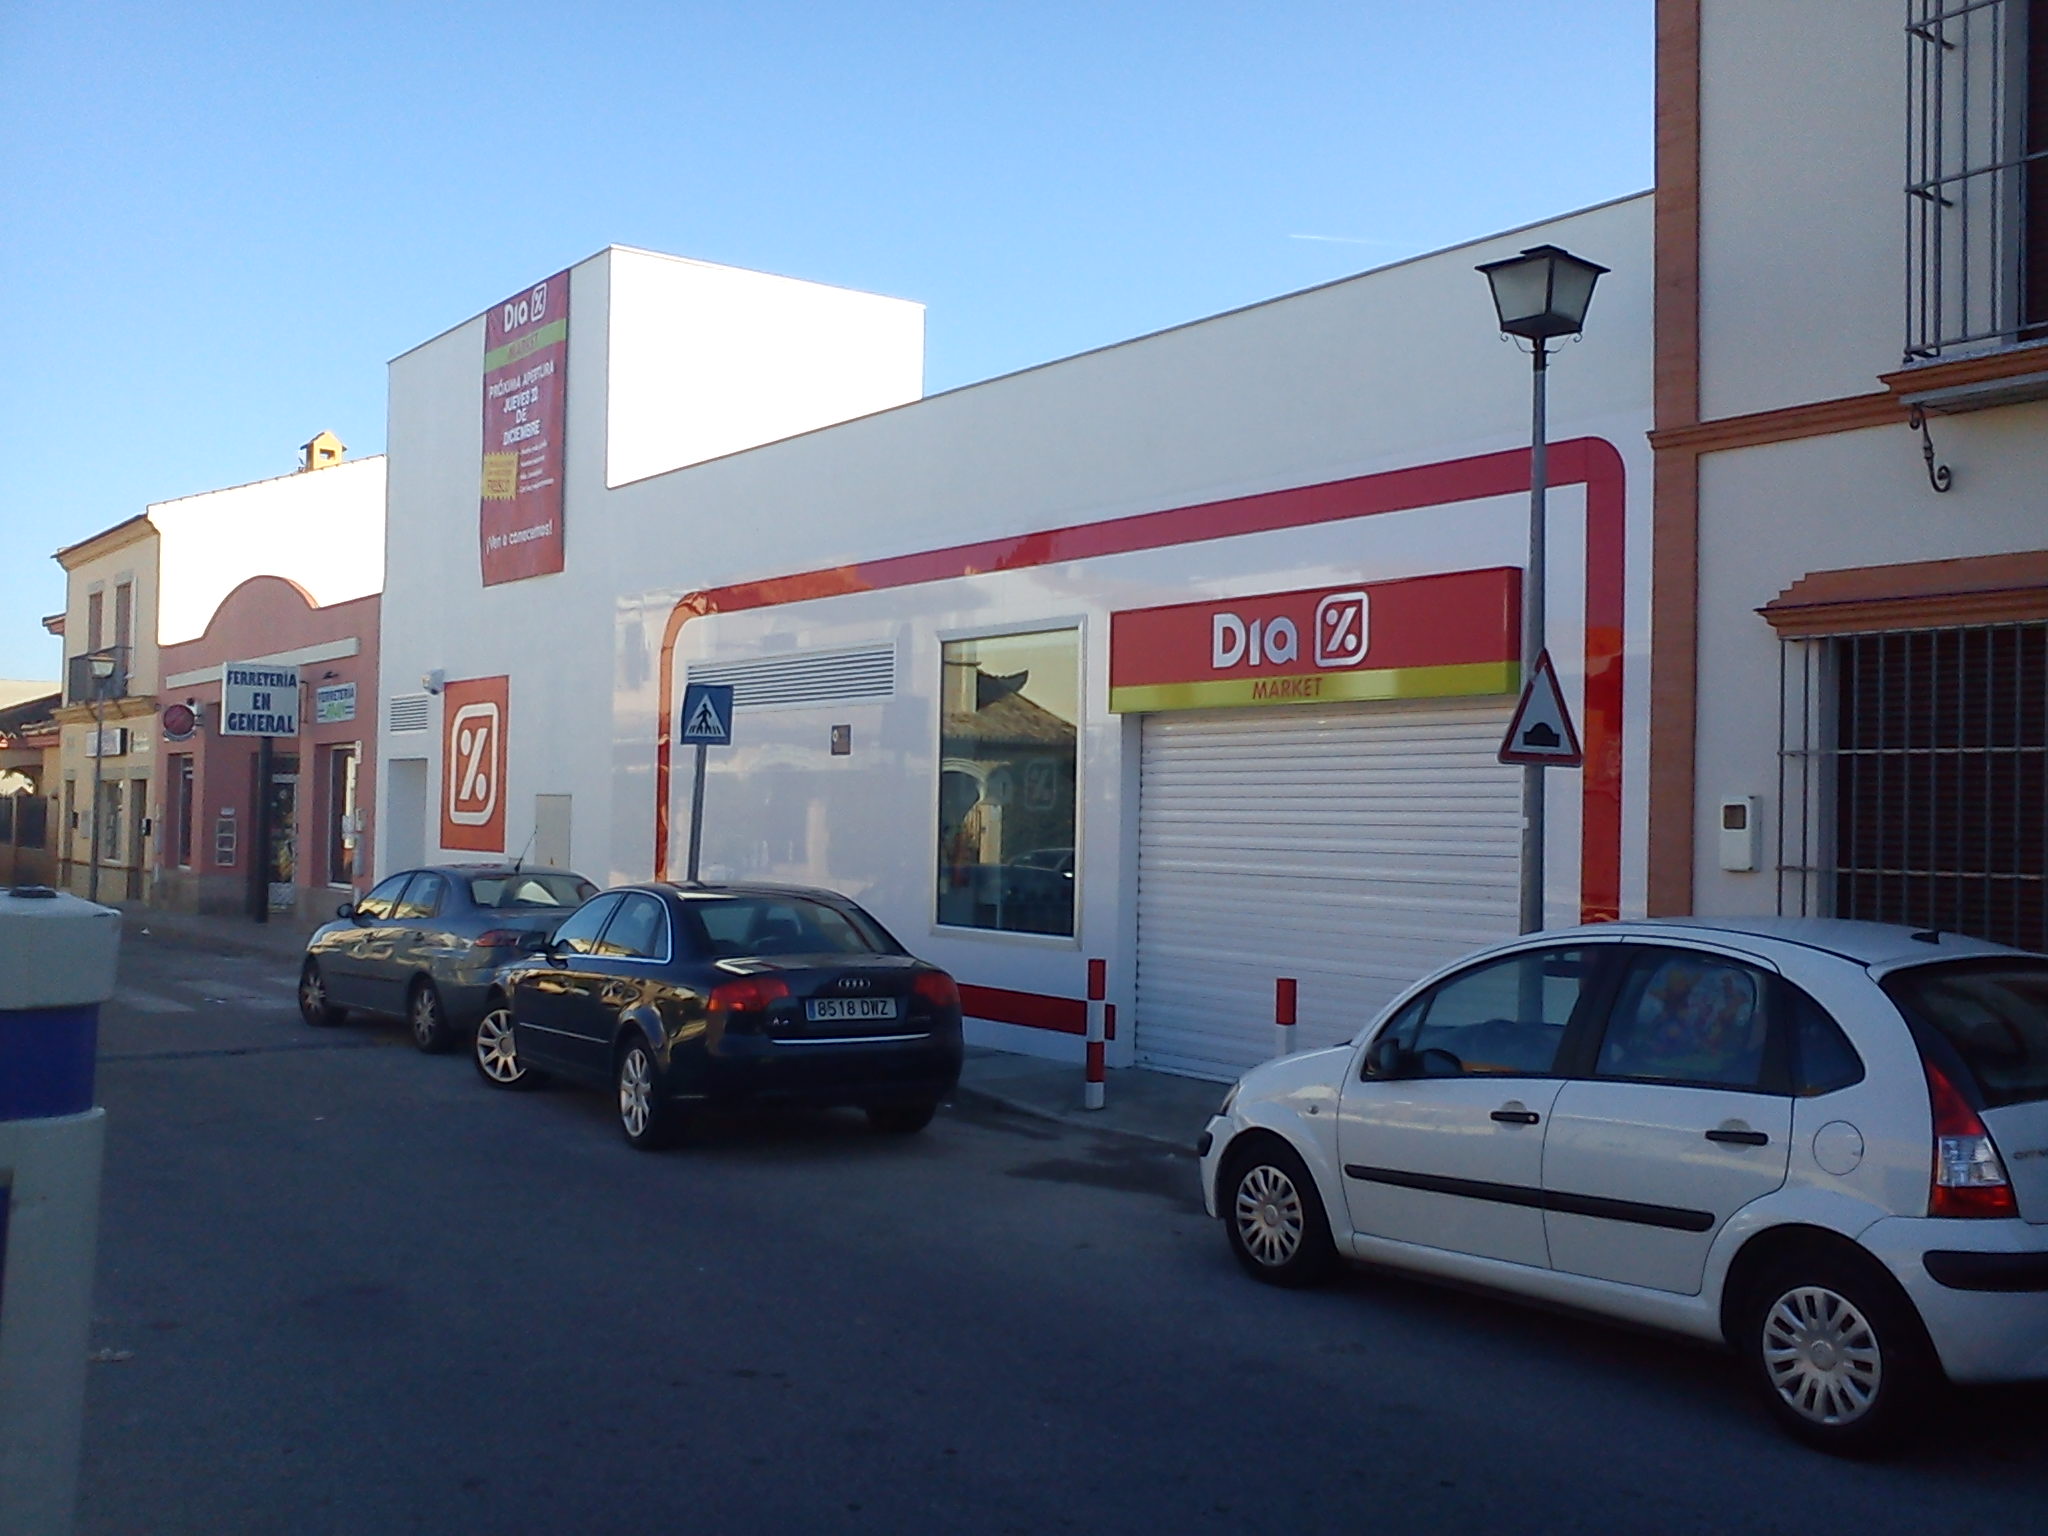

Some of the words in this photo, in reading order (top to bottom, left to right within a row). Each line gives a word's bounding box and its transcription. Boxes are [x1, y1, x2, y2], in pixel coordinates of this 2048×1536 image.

[522, 360, 554, 385] APERTURA
[503, 389, 530, 413] JUEVES
[515, 408, 528, 424] DE
[502, 419, 541, 446] DICIEMBRE
[226, 670, 297, 687] FERRETERÍA
[1252, 677, 1323, 700] MARKET
[253, 692, 271, 711] EN
[227, 712, 295, 733] GENERAL
[817, 1001, 856, 1016] 8518
[861, 1000, 889, 1017] DWZ
